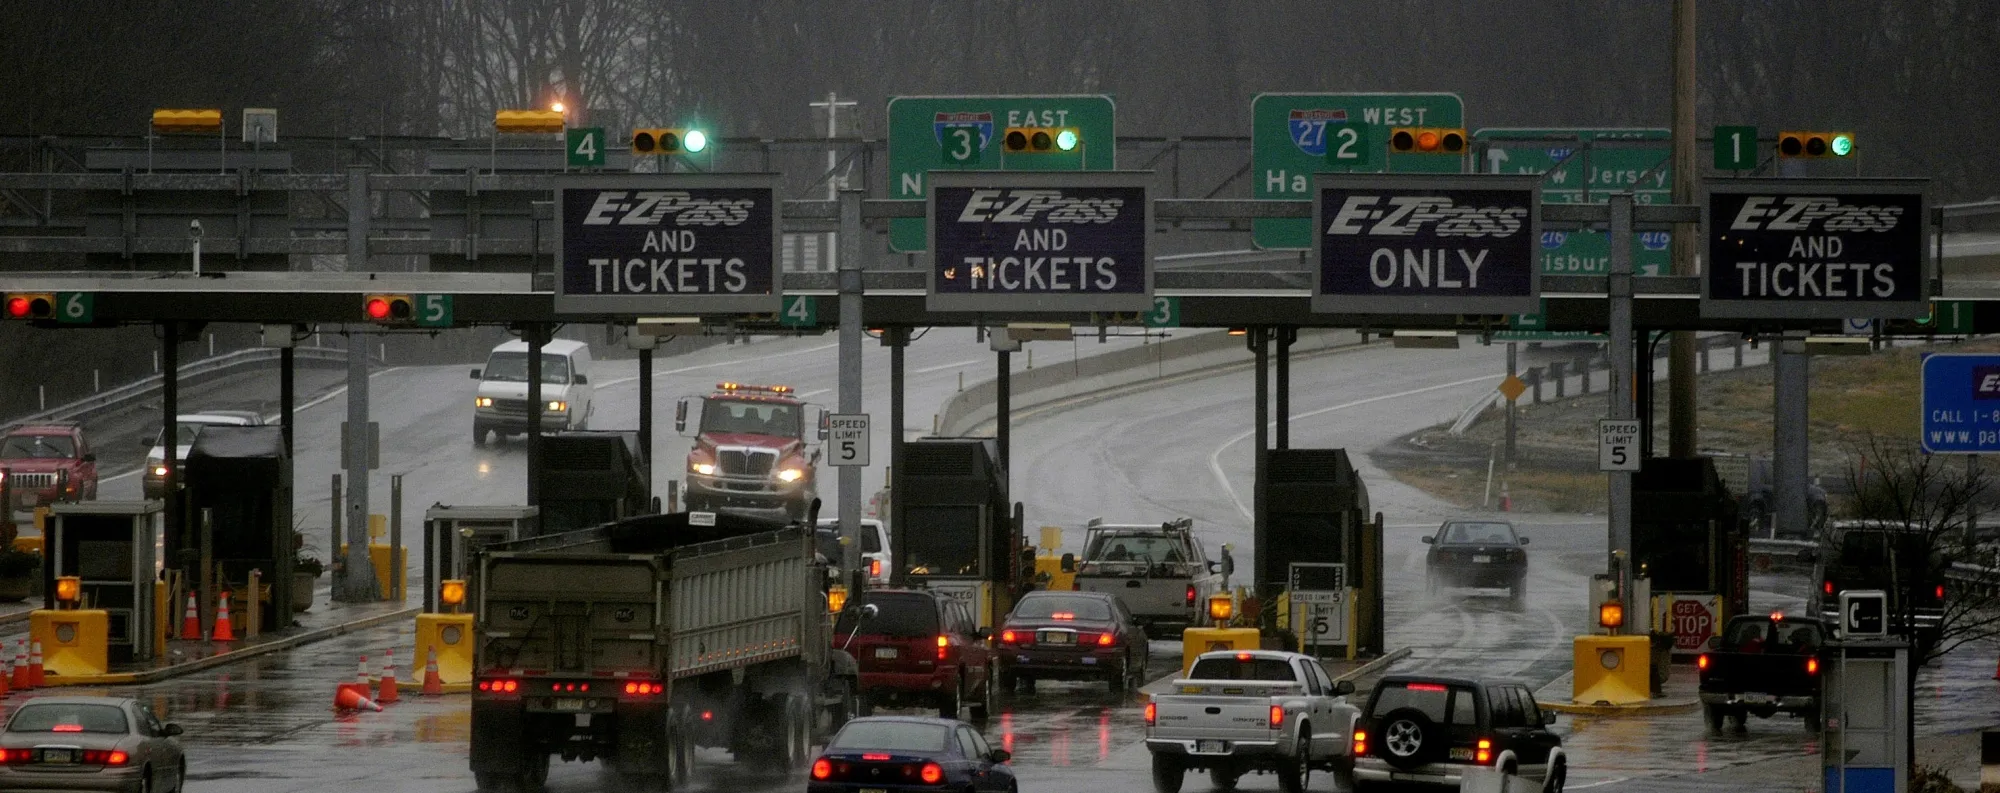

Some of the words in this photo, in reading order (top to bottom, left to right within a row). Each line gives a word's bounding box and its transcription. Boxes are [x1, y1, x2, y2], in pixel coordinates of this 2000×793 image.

[1007, 110, 1069, 128] EAST
[1362, 107, 1428, 126] WEST
[575, 132, 596, 161] 4
[951, 129, 972, 160] 3
[1336, 128, 1358, 159] 2
[1731, 132, 1741, 163] 1
[582, 191, 754, 227] E-ZPass
[957, 189, 1124, 224] E-ZPass
[1327, 195, 1528, 238] E-ZPass
[1730, 196, 1904, 233] E-ZPass
[641, 230, 697, 253] AND
[1013, 228, 1068, 251] AND
[1788, 235, 1843, 258] AND
[587, 257, 748, 293] TICKETS
[964, 257, 1117, 290] TICKETS
[1369, 247, 1490, 289] ONLY
[1735, 261, 1896, 298] TICKETS
[66, 292, 85, 319] 6
[425, 295, 445, 321] 5
[788, 295, 808, 322] 4
[1153, 299, 1171, 323] 3
[1952, 302, 1960, 329] 1
[832, 420, 867, 429] SPEED
[1932, 409, 1964, 423] CALL
[835, 431, 862, 440] LIMIT
[1602, 425, 1638, 434] SPEED
[1606, 436, 1632, 445] LIMIT
[842, 441, 856, 460] 5
[1612, 446, 1626, 465] 5
[1333, 592, 1340, 603] 5
[1676, 603, 1698, 614] GET
[1309, 606, 1334, 616] LIMIT
[1314, 616, 1329, 635] 5
